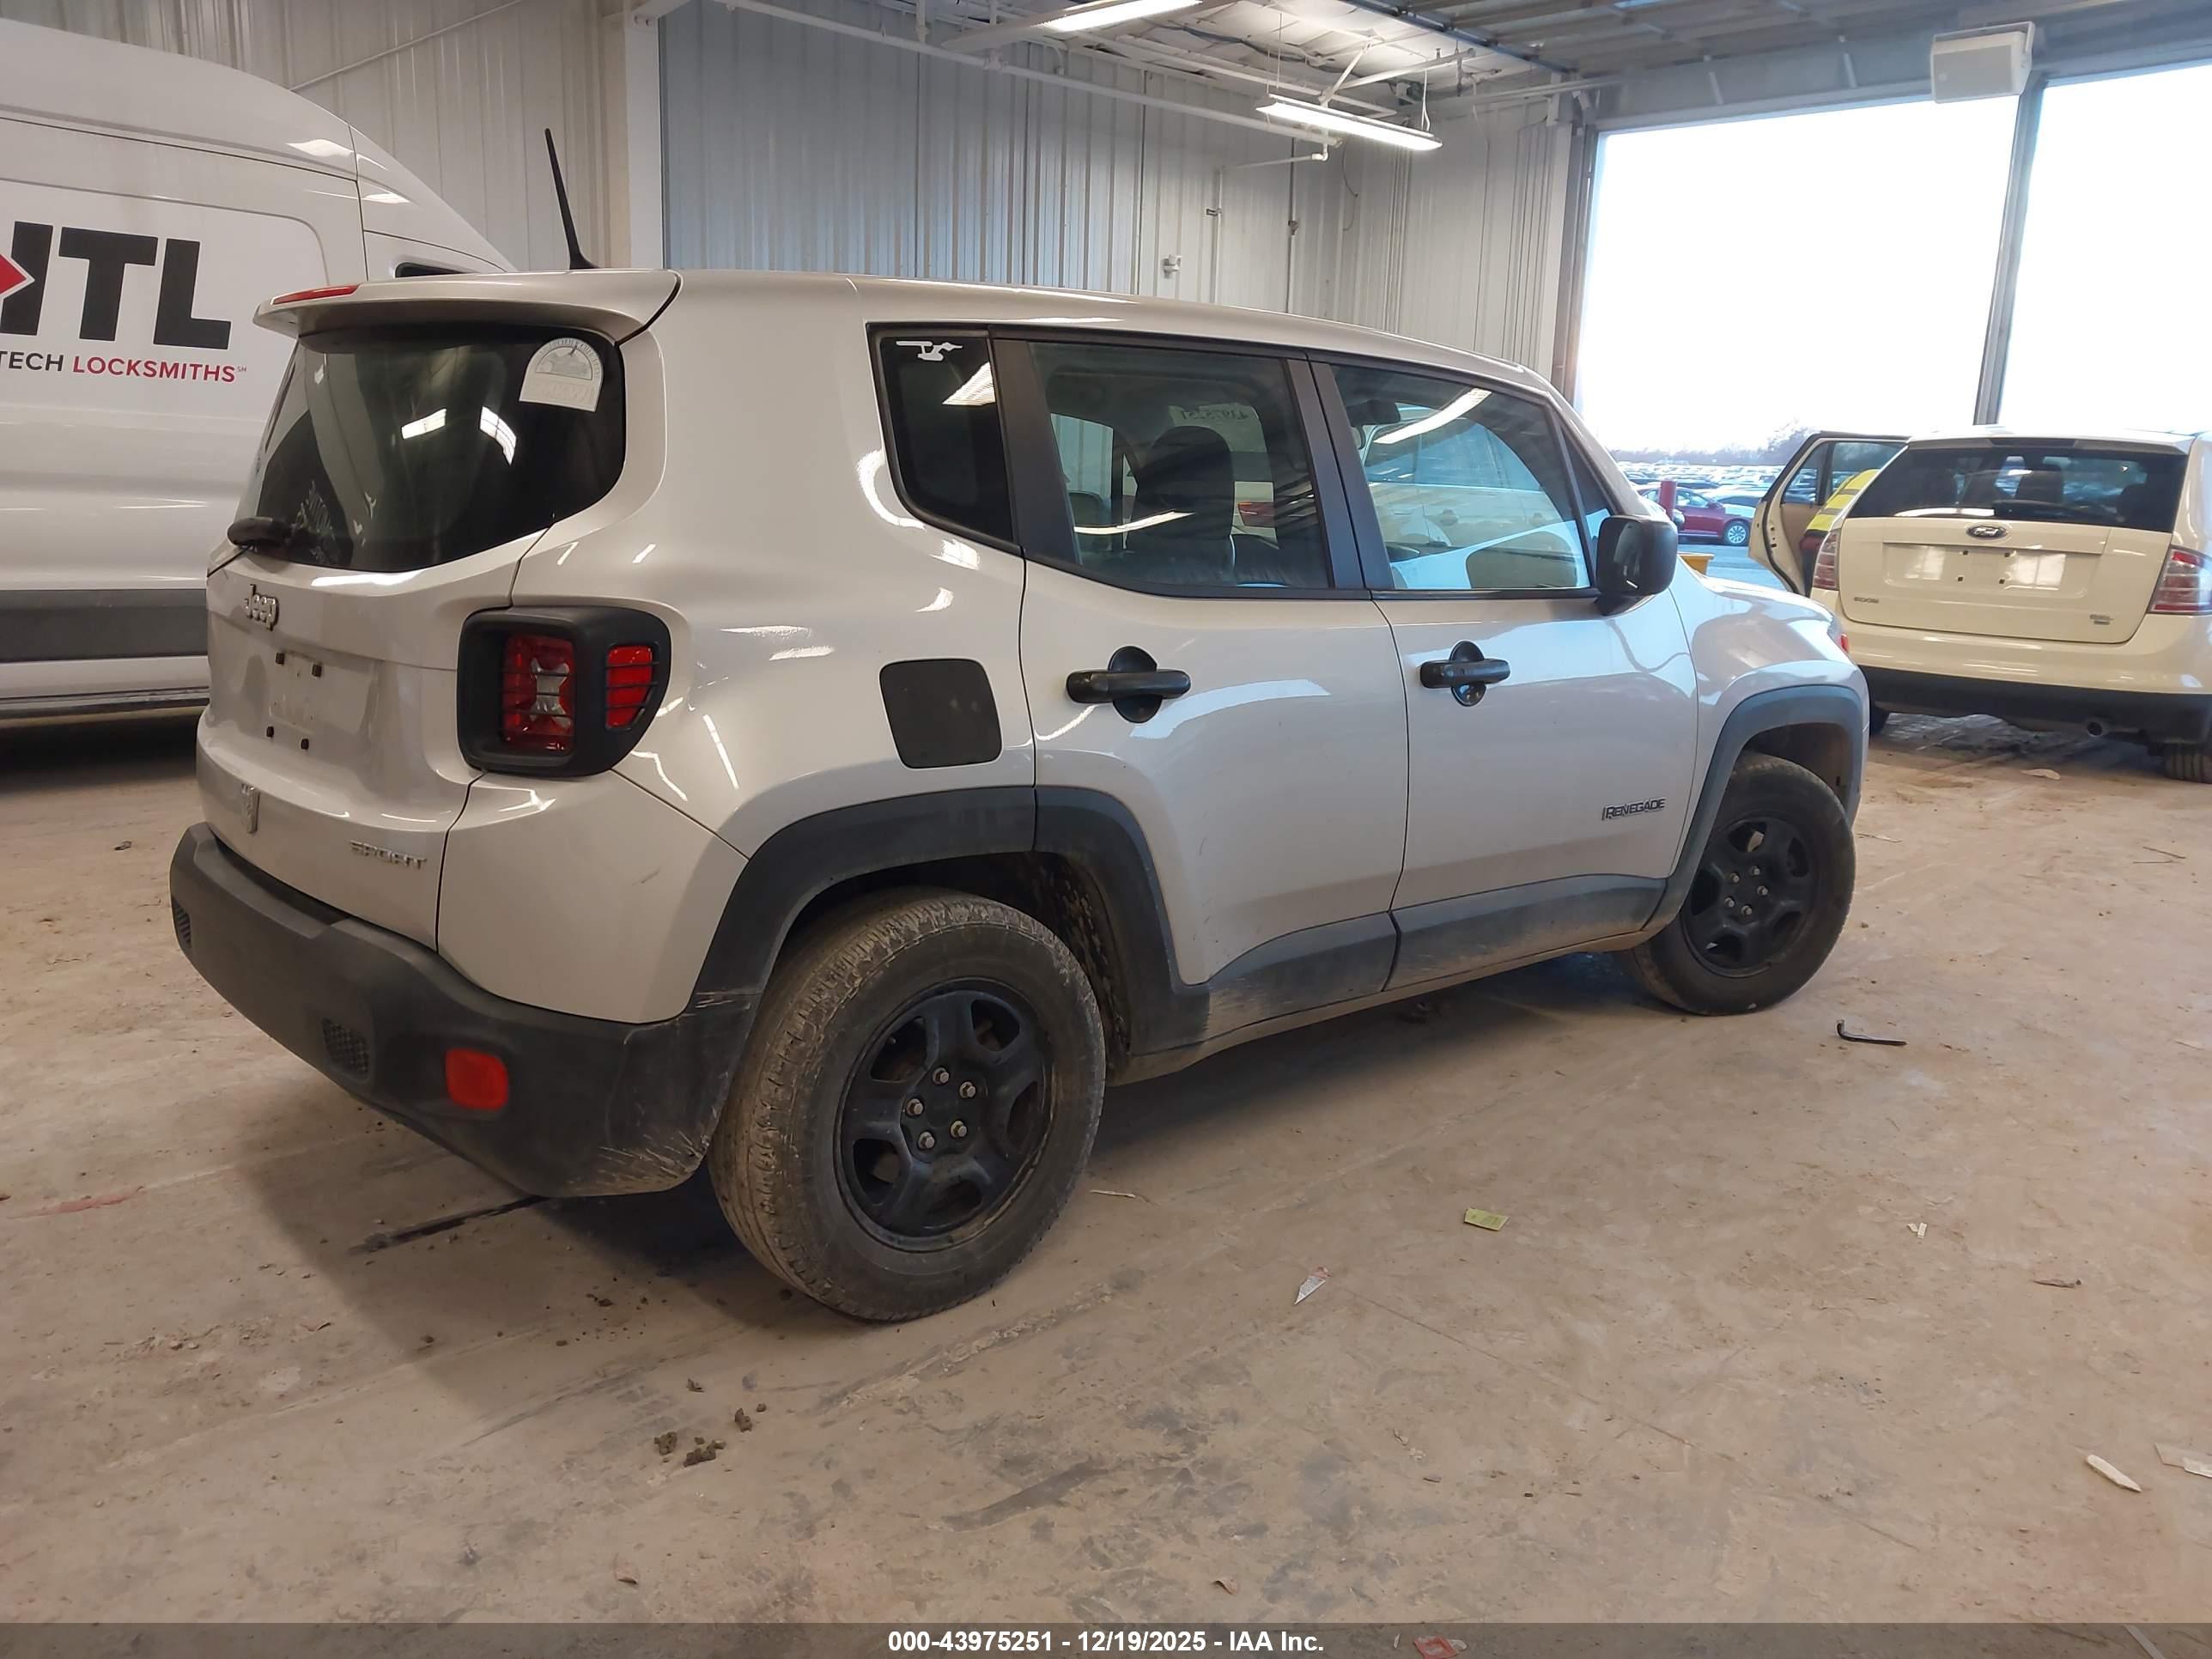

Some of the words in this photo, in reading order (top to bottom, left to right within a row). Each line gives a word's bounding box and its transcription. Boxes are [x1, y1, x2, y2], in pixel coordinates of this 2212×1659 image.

[73, 356, 236, 383] LOCKSMITHS
[245, 584, 279, 632] Jeep
[1604, 799, 1666, 819] RENEGADE
[350, 840, 428, 869] SPORT
